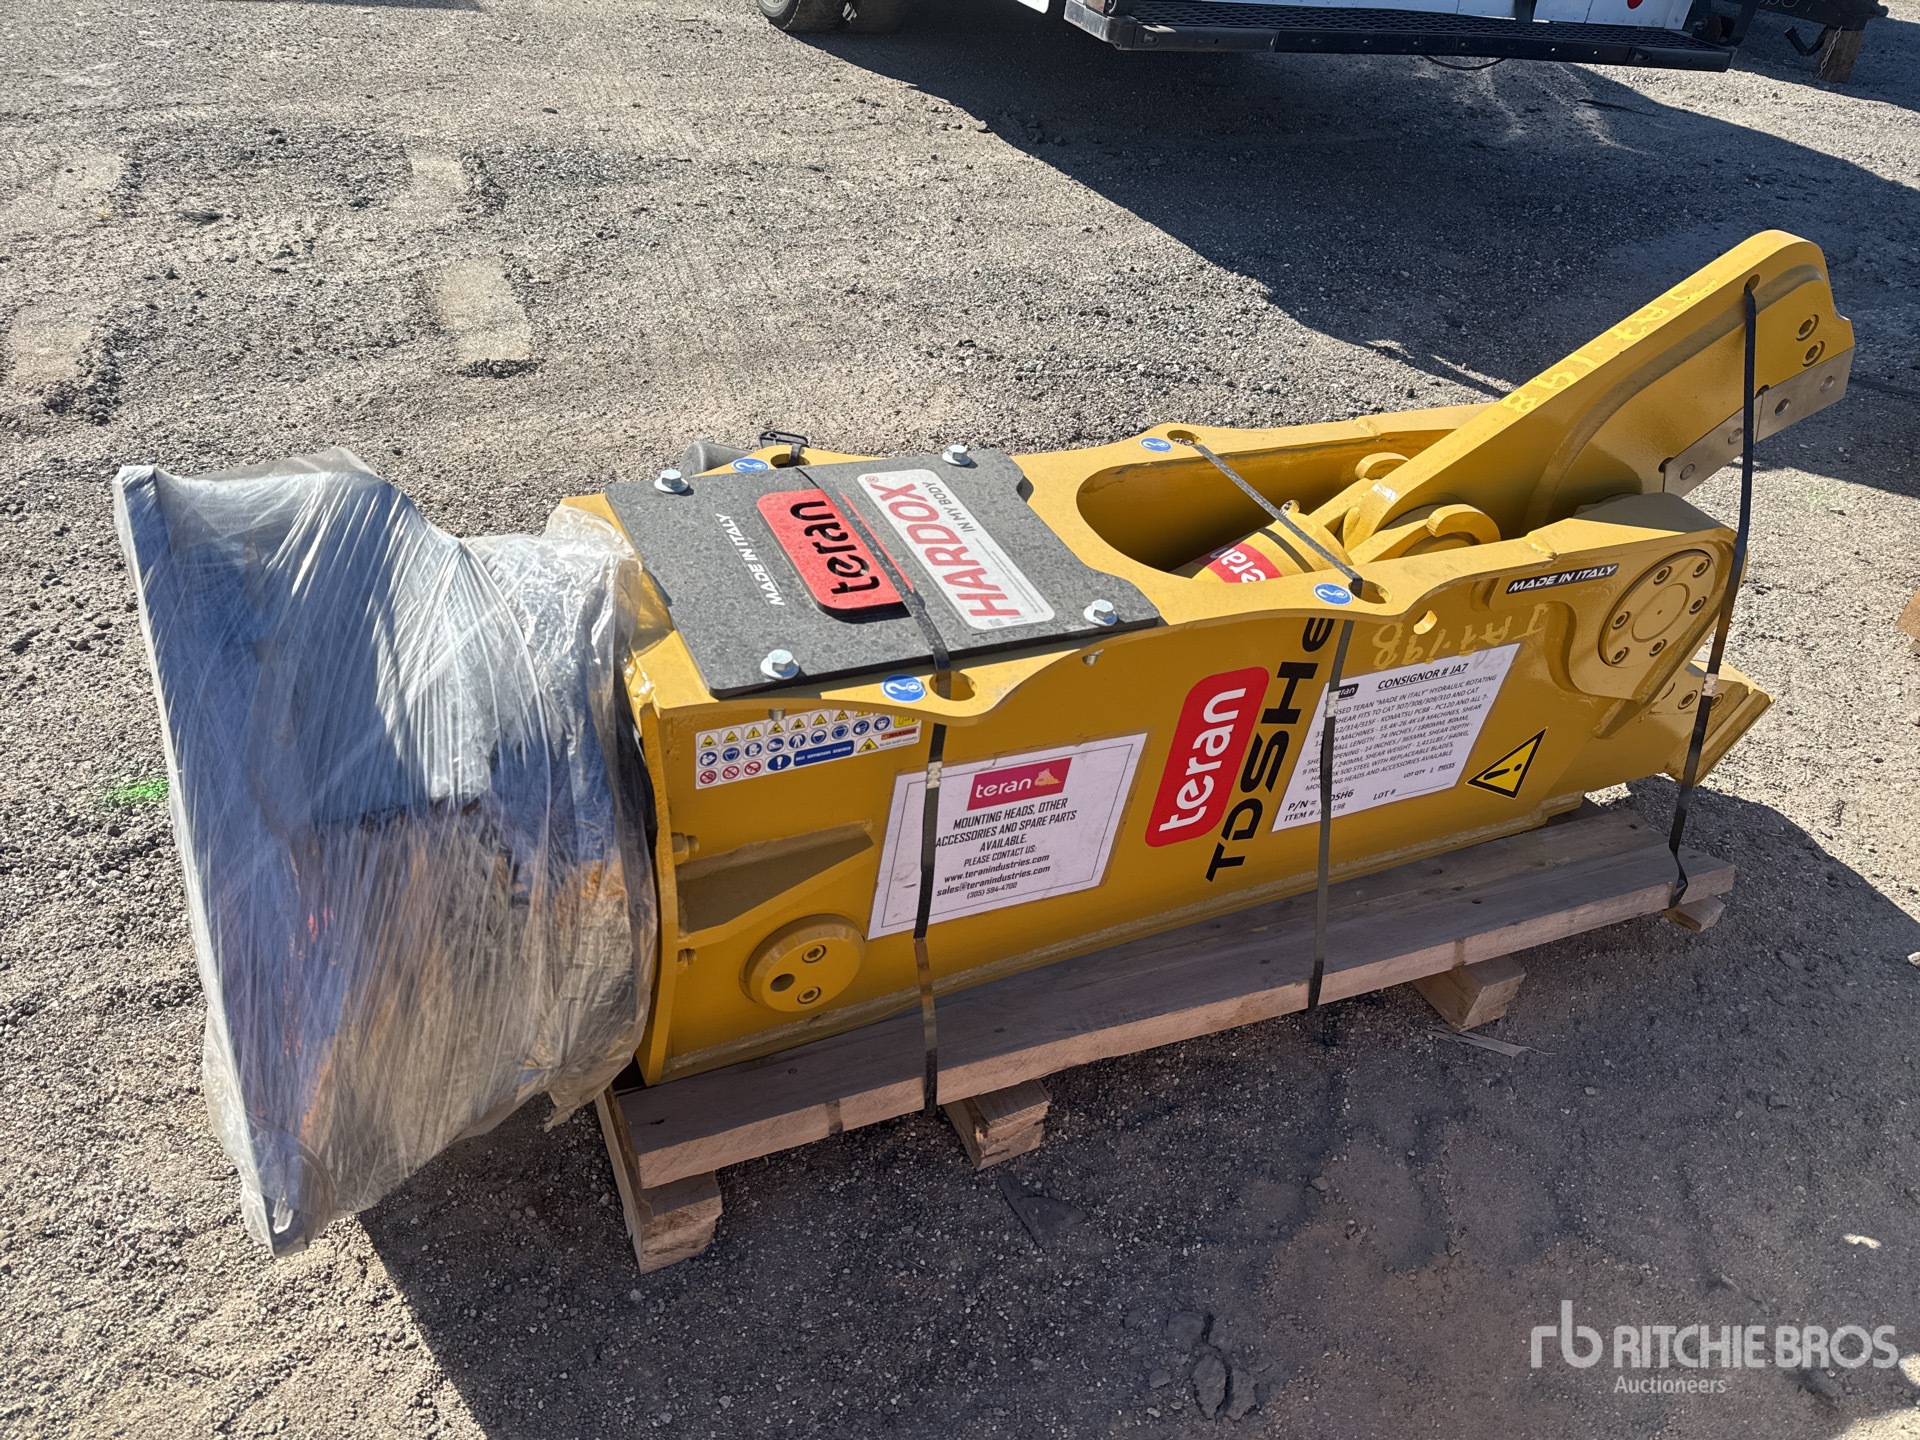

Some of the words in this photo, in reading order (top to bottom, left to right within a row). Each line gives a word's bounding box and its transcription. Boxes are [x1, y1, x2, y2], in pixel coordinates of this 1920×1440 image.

[922, 481, 951, 506] BODY
[944, 507, 967, 521] MY
[957, 522, 976, 533] IN
[715, 513, 748, 545] ITALY
[738, 548, 758, 560] IN
[790, 501, 880, 594] teran
[1209, 547, 1266, 583] eran
[1508, 574, 1558, 592] MADE
[1558, 572, 1576, 583] IN
[1575, 565, 1618, 580] ITALY
[747, 563, 785, 605] MADE
[1377, 668, 1440, 689] CONSIGNOR
[1440, 666, 1449, 676] #
[1449, 662, 1468, 674] JA7
[1335, 714, 1356, 724] SHEAR
[1357, 710, 1371, 719] FITS
[1381, 704, 1395, 713] CAT
[1395, 693, 1451, 710] 307/308/309/310
[1450, 689, 1466, 698] AND
[1466, 686, 1479, 695] CAT
[1352, 701, 1374, 711] TERAN
[1428, 681, 1465, 694] HYDRAULIC
[1464, 674, 1497, 686] ROTATING
[1340, 727, 1374, 740] MACHINES
[1379, 717, 1417, 731] 15.4K-26.4K
[1461, 703, 1482, 713] SHEAR
[1380, 710, 1413, 722] KOMATSU
[1413, 706, 1430, 714] PC88
[1434, 700, 1455, 710] PC120
[1454, 697, 1469, 706] AND
[1349, 735, 1375, 747] LENGTH
[1388, 726, 1411, 737] INCHES
[1364, 744, 1372, 752] 14
[1372, 738, 1396, 749] INCHES
[1427, 726, 1448, 736] SHEAR
[1448, 722, 1470, 731] DEPTH
[1158, 687, 1247, 832] teran
[1300, 768, 1308, 776] 9
[1364, 749, 1385, 760] SHEAR
[1386, 742, 1412, 754] WEIGHT
[1339, 766, 1352, 775] 500
[1352, 762, 1369, 772] STEEL
[1371, 757, 1388, 766] WITH
[1388, 746, 1430, 761] REPLACEABLE
[1343, 771, 1365, 782] HEADS
[1365, 767, 1380, 776] AND
[1379, 757, 1420, 772] ACCESSORIES
[1420, 749, 1453, 761] AVAILABLE
[975, 777, 1032, 798] teran
[1372, 789, 1390, 800] LOT
[952, 810, 1002, 830] MOUNTING
[1003, 804, 1035, 820] HEADS,
[1037, 797, 1068, 813] OTHER
[1284, 811, 1307, 821] ITEM
[1287, 799, 1308, 811] P/N
[936, 825, 997, 847] ACCESSORIES
[998, 821, 1017, 834] AND
[1018, 815, 1048, 830] SPARE
[1048, 809, 1077, 824] PARTS
[963, 853, 990, 867] PLEASE
[991, 846, 1024, 861] CONTACT
[1024, 844, 1036, 854] US:
[979, 833, 1026, 852] AVAILABLE.
[936, 865, 1050, 896] sales@teranindustries.com
[944, 854, 1049, 882] www.teranindustries.com
[966, 888, 985, 899] (305)
